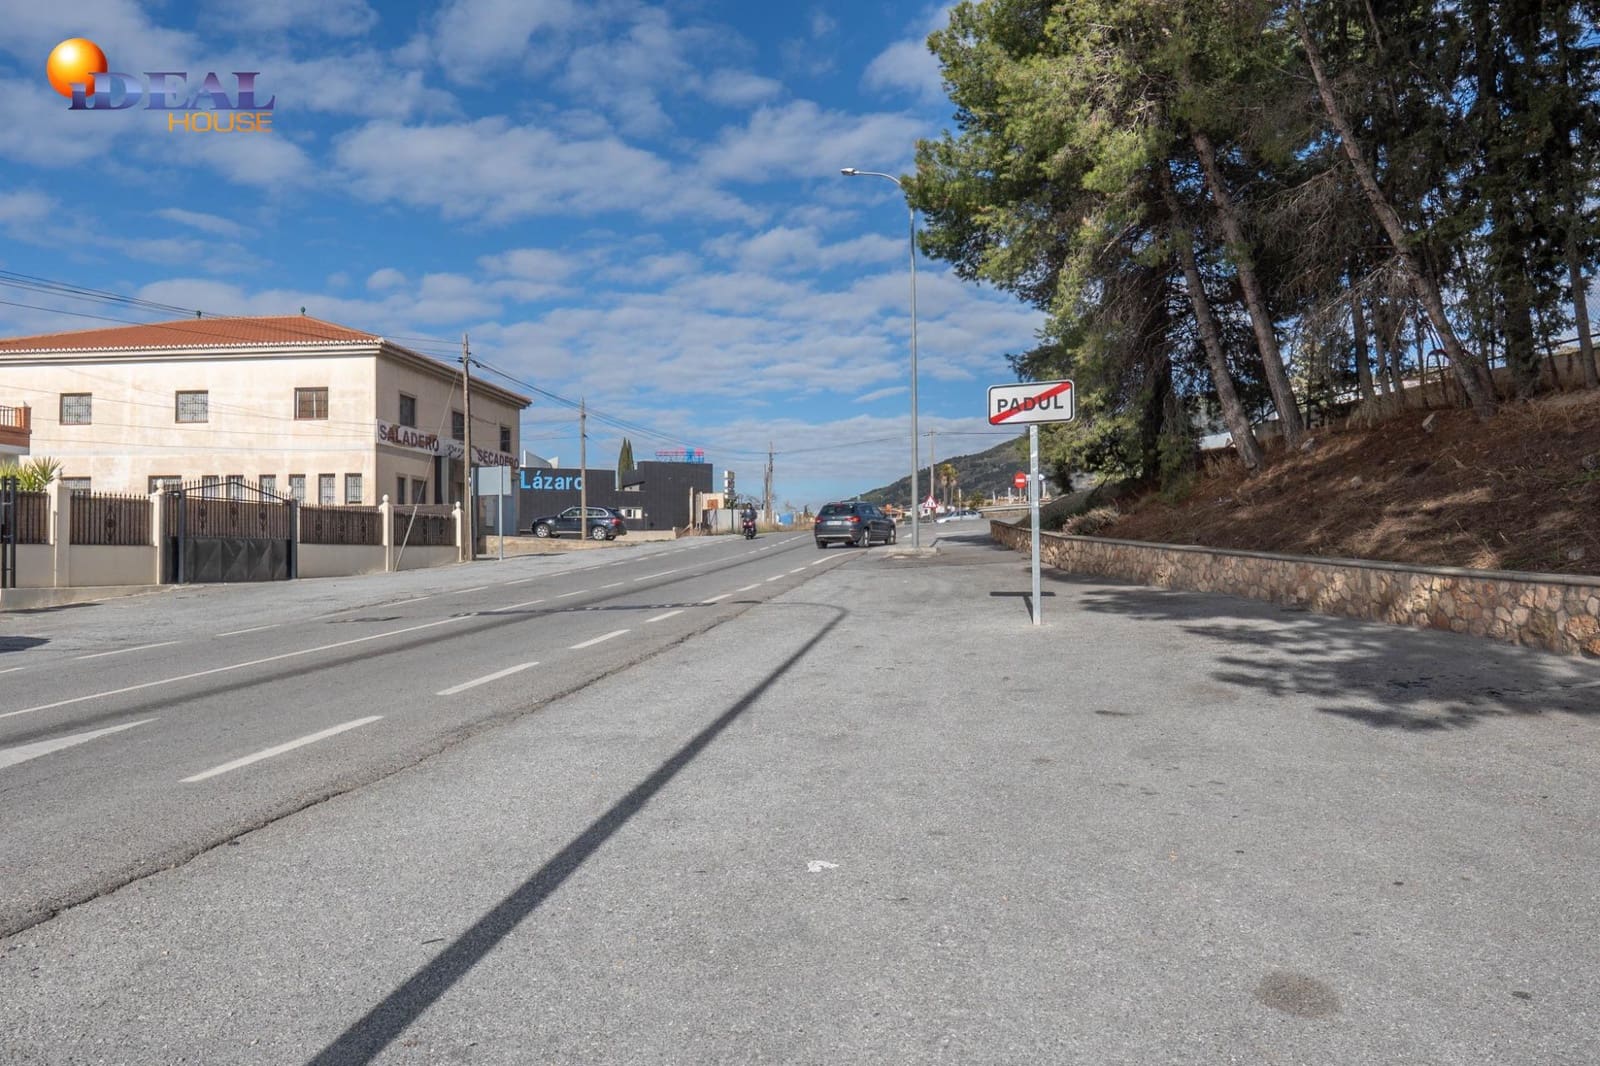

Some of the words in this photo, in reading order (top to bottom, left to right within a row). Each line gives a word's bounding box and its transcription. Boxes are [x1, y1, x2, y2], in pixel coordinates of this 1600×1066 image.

[997, 395, 1064, 412] PADUL
[379, 424, 440, 452] SALADERO
[477, 448, 519, 470] SECADERO
